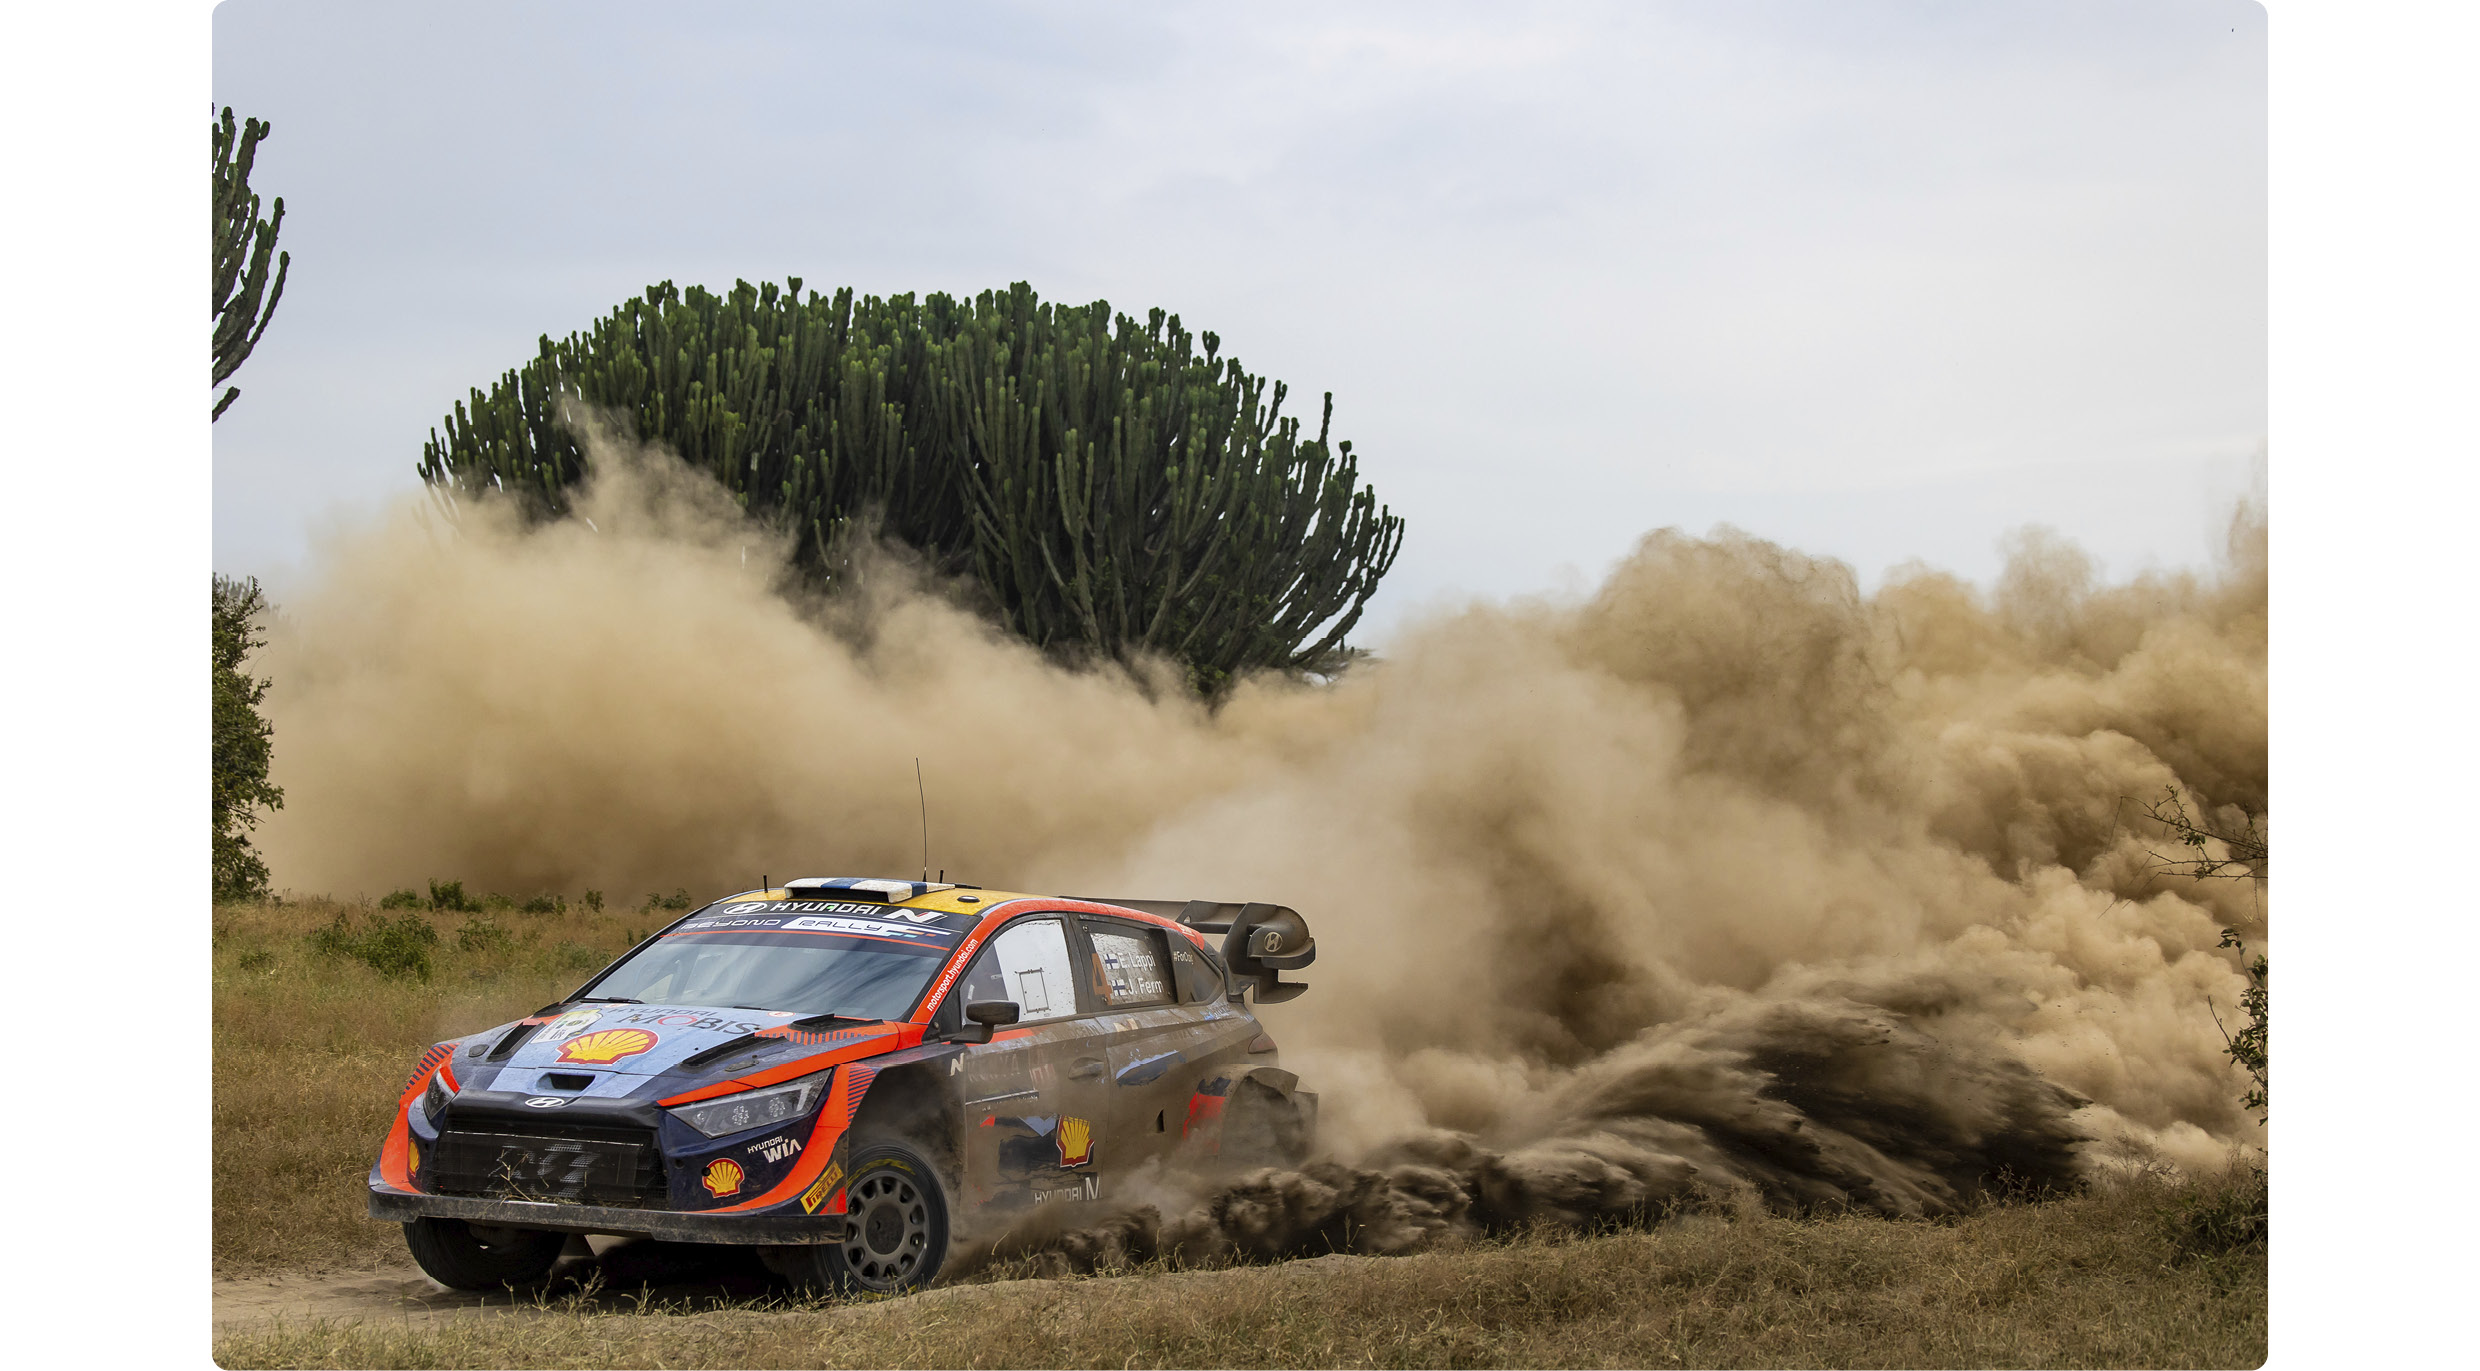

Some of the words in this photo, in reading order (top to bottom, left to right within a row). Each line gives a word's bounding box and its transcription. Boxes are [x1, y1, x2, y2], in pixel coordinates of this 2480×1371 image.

[770, 902, 882, 915] HYUNDAI
[680, 920, 781, 930] BEYOND
[798, 920, 883, 931] RALLY
[1132, 951, 1157, 972] Lappi
[926, 938, 979, 1012] motorsport.hyundai.com
[1091, 953, 1113, 1006] 4
[1138, 978, 1165, 994] Ferm
[607, 1008, 718, 1016] HYUNDAI
[617, 1013, 762, 1035] MOBIS
[950, 1052, 965, 1076] N
[747, 1135, 784, 1154] HYUNDAI
[805, 1166, 838, 1209] PIRELLI
[1034, 1186, 1082, 1205] HYUNDAI
